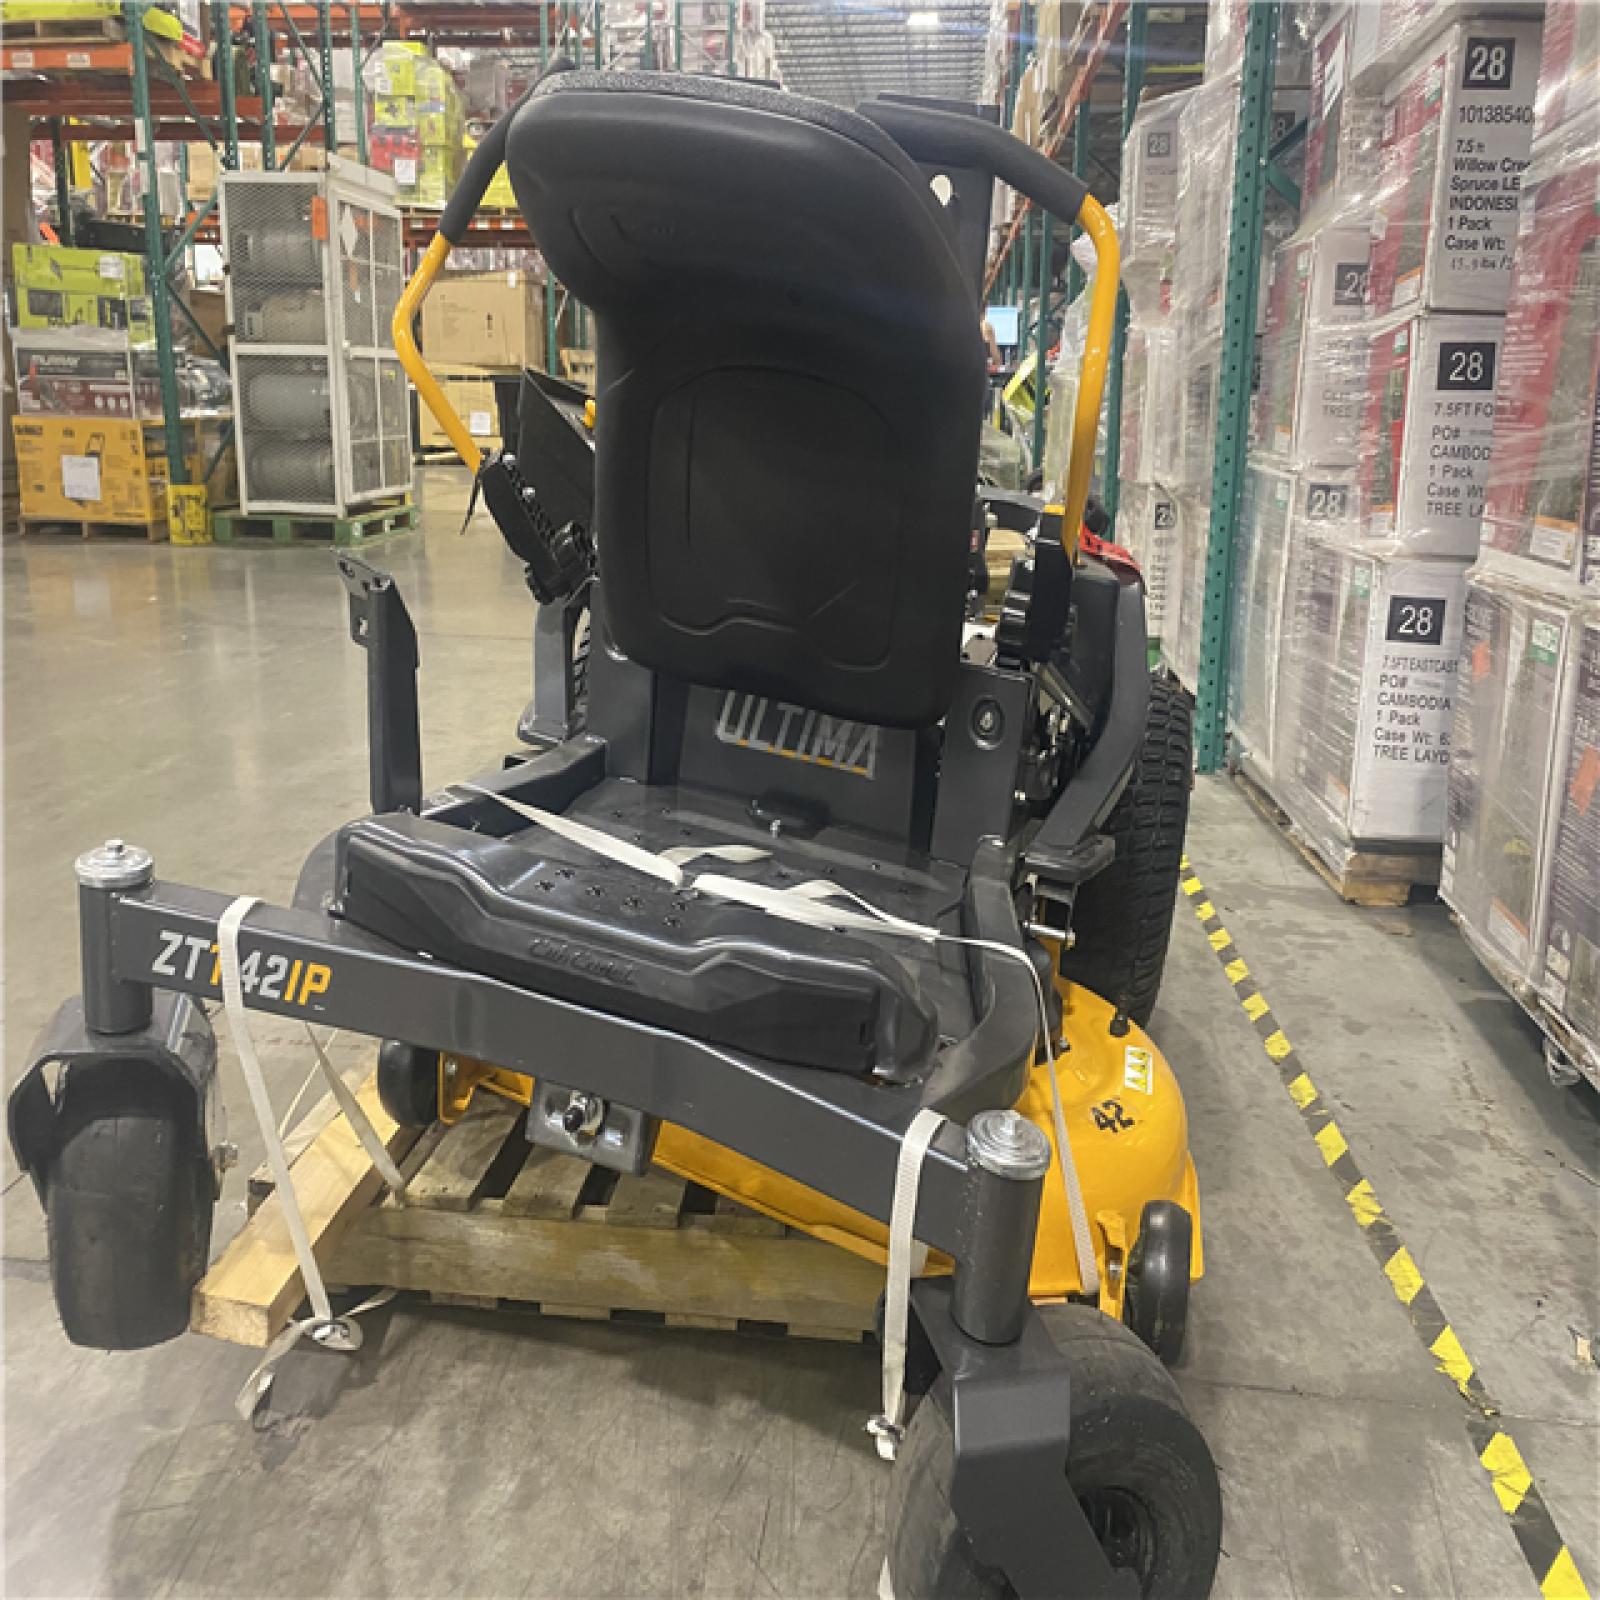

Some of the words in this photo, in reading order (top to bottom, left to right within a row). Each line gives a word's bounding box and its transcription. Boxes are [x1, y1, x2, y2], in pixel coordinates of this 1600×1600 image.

[1469, 45, 1506, 81] 28
[1453, 157, 1498, 171] Willow
[1450, 177, 1499, 193] Spruce
[1502, 177, 1520, 190] LE
[1449, 196, 1518, 210] INDONESI
[1457, 216, 1492, 230] Pack
[1444, 236, 1479, 250] Case
[1449, 351, 1484, 381] 28
[1432, 426, 1461, 440] PO#
[1442, 465, 1473, 478] Pack
[1427, 482, 1461, 497] Case
[1310, 489, 1341, 518] 28
[1426, 502, 1462, 516] TREE
[1398, 604, 1434, 636] 28
[1379, 674, 1408, 688] PO#
[1389, 710, 1420, 727] Pack
[715, 690, 880, 780] ULTIMA
[1374, 727, 1405, 743] Case
[1373, 745, 1408, 761] TREE
